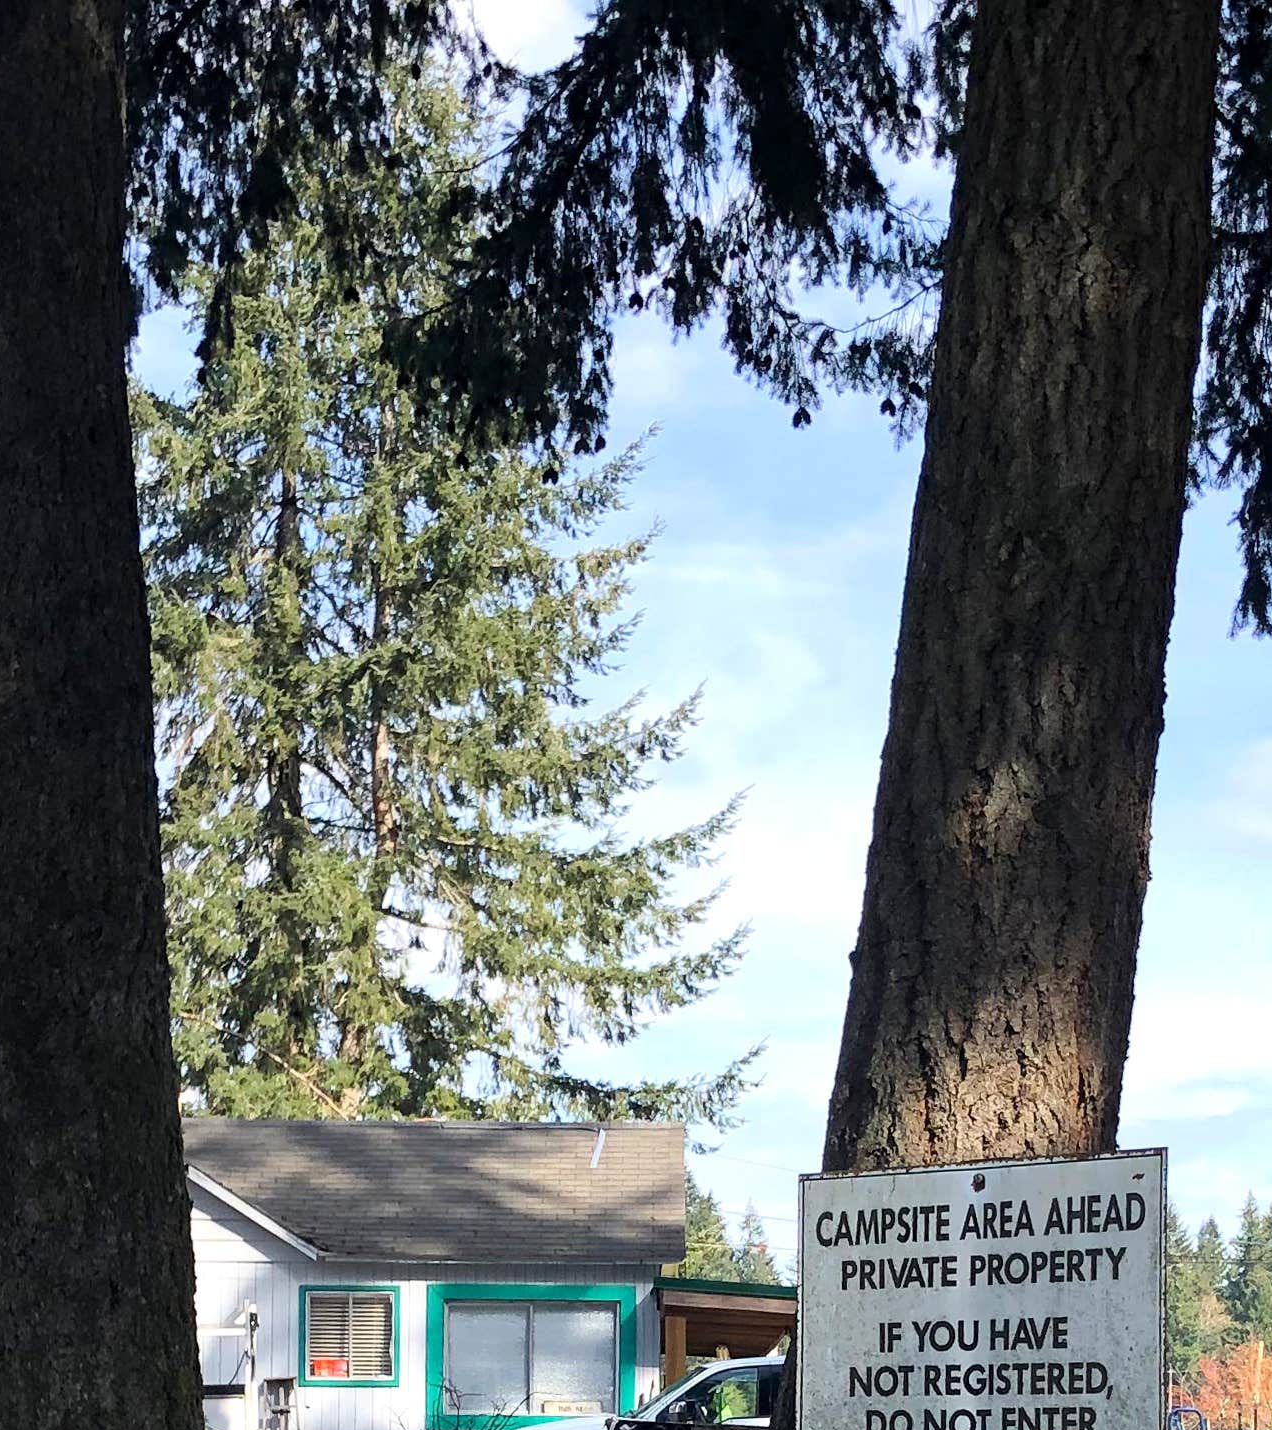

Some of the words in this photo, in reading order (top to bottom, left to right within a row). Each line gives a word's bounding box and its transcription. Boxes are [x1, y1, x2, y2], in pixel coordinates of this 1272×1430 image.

[816, 1205, 951, 1247] CAMPSITE
[960, 1199, 1034, 1240] AREA
[1044, 1192, 1145, 1236] AHEAD
[841, 1255, 958, 1290] PRIVATE
[970, 1247, 1127, 1286] PROPERTY
[879, 1322, 902, 1353] IF
[912, 1320, 979, 1352] YOU
[990, 1316, 1068, 1351] HAVE
[849, 1365, 914, 1397] NOT
[924, 1362, 1113, 1400] REGISTERED,
